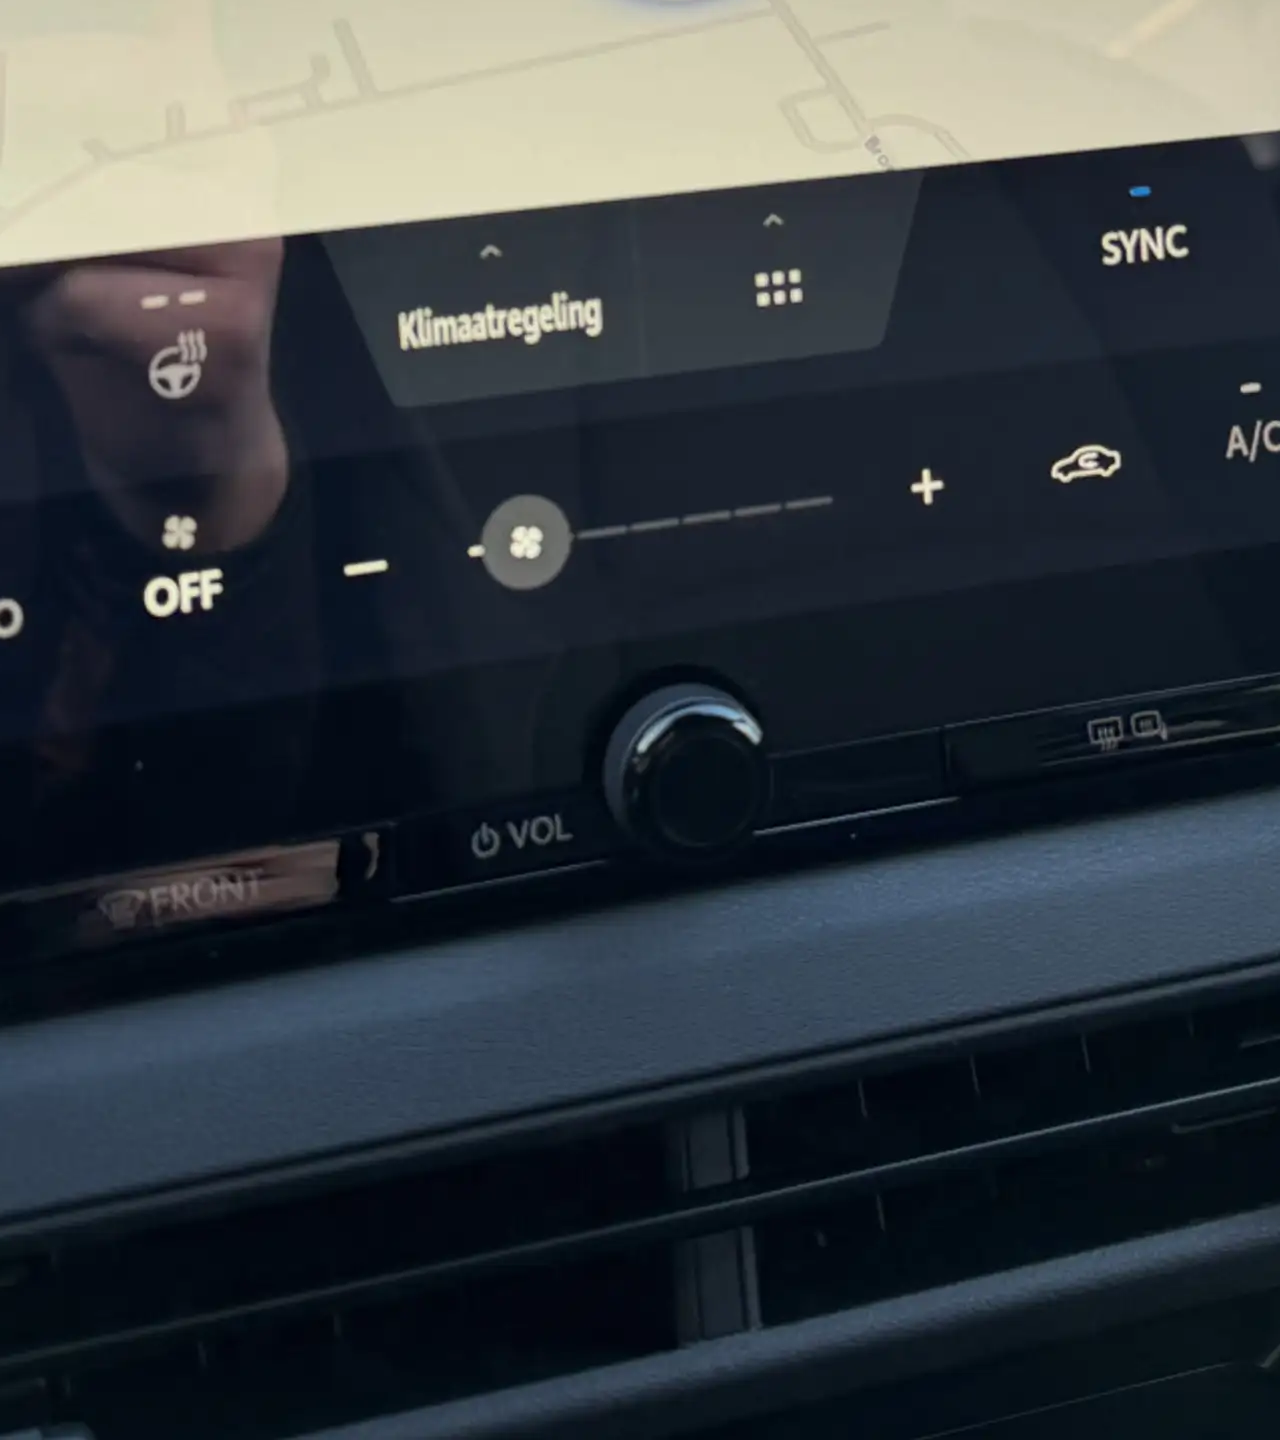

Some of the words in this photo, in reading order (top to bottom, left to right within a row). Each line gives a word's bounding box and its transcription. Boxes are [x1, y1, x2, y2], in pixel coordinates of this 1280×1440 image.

[1101, 224, 1189, 266] SYNC
[397, 291, 604, 351] Klimaatregeling
[143, 569, 224, 618] OFF
[507, 814, 573, 851] VOL
[148, 870, 265, 918] FRONT
